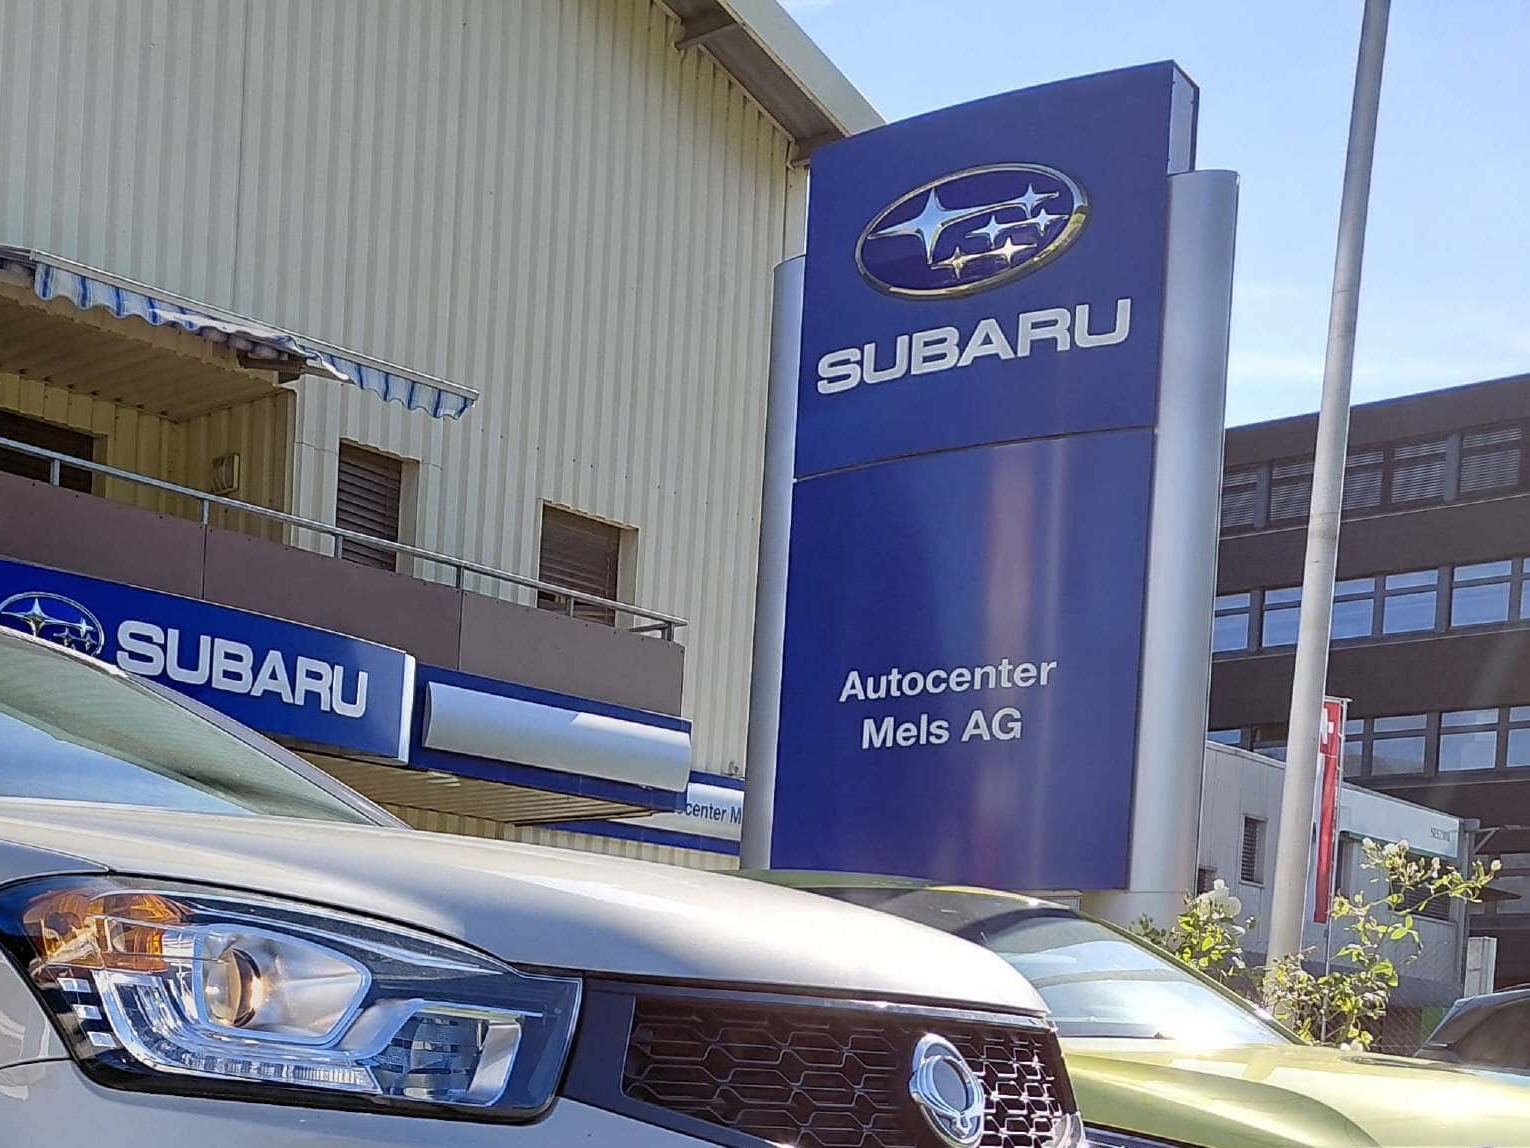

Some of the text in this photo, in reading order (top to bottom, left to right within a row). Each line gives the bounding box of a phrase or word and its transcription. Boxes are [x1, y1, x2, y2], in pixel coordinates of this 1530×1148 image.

[817, 298, 1131, 394] SUBARU
[116, 620, 369, 718] SUBARU
[839, 658, 1058, 702] Autocenter
[862, 707, 1022, 749] Mels AG
[677, 802, 727, 821] center
